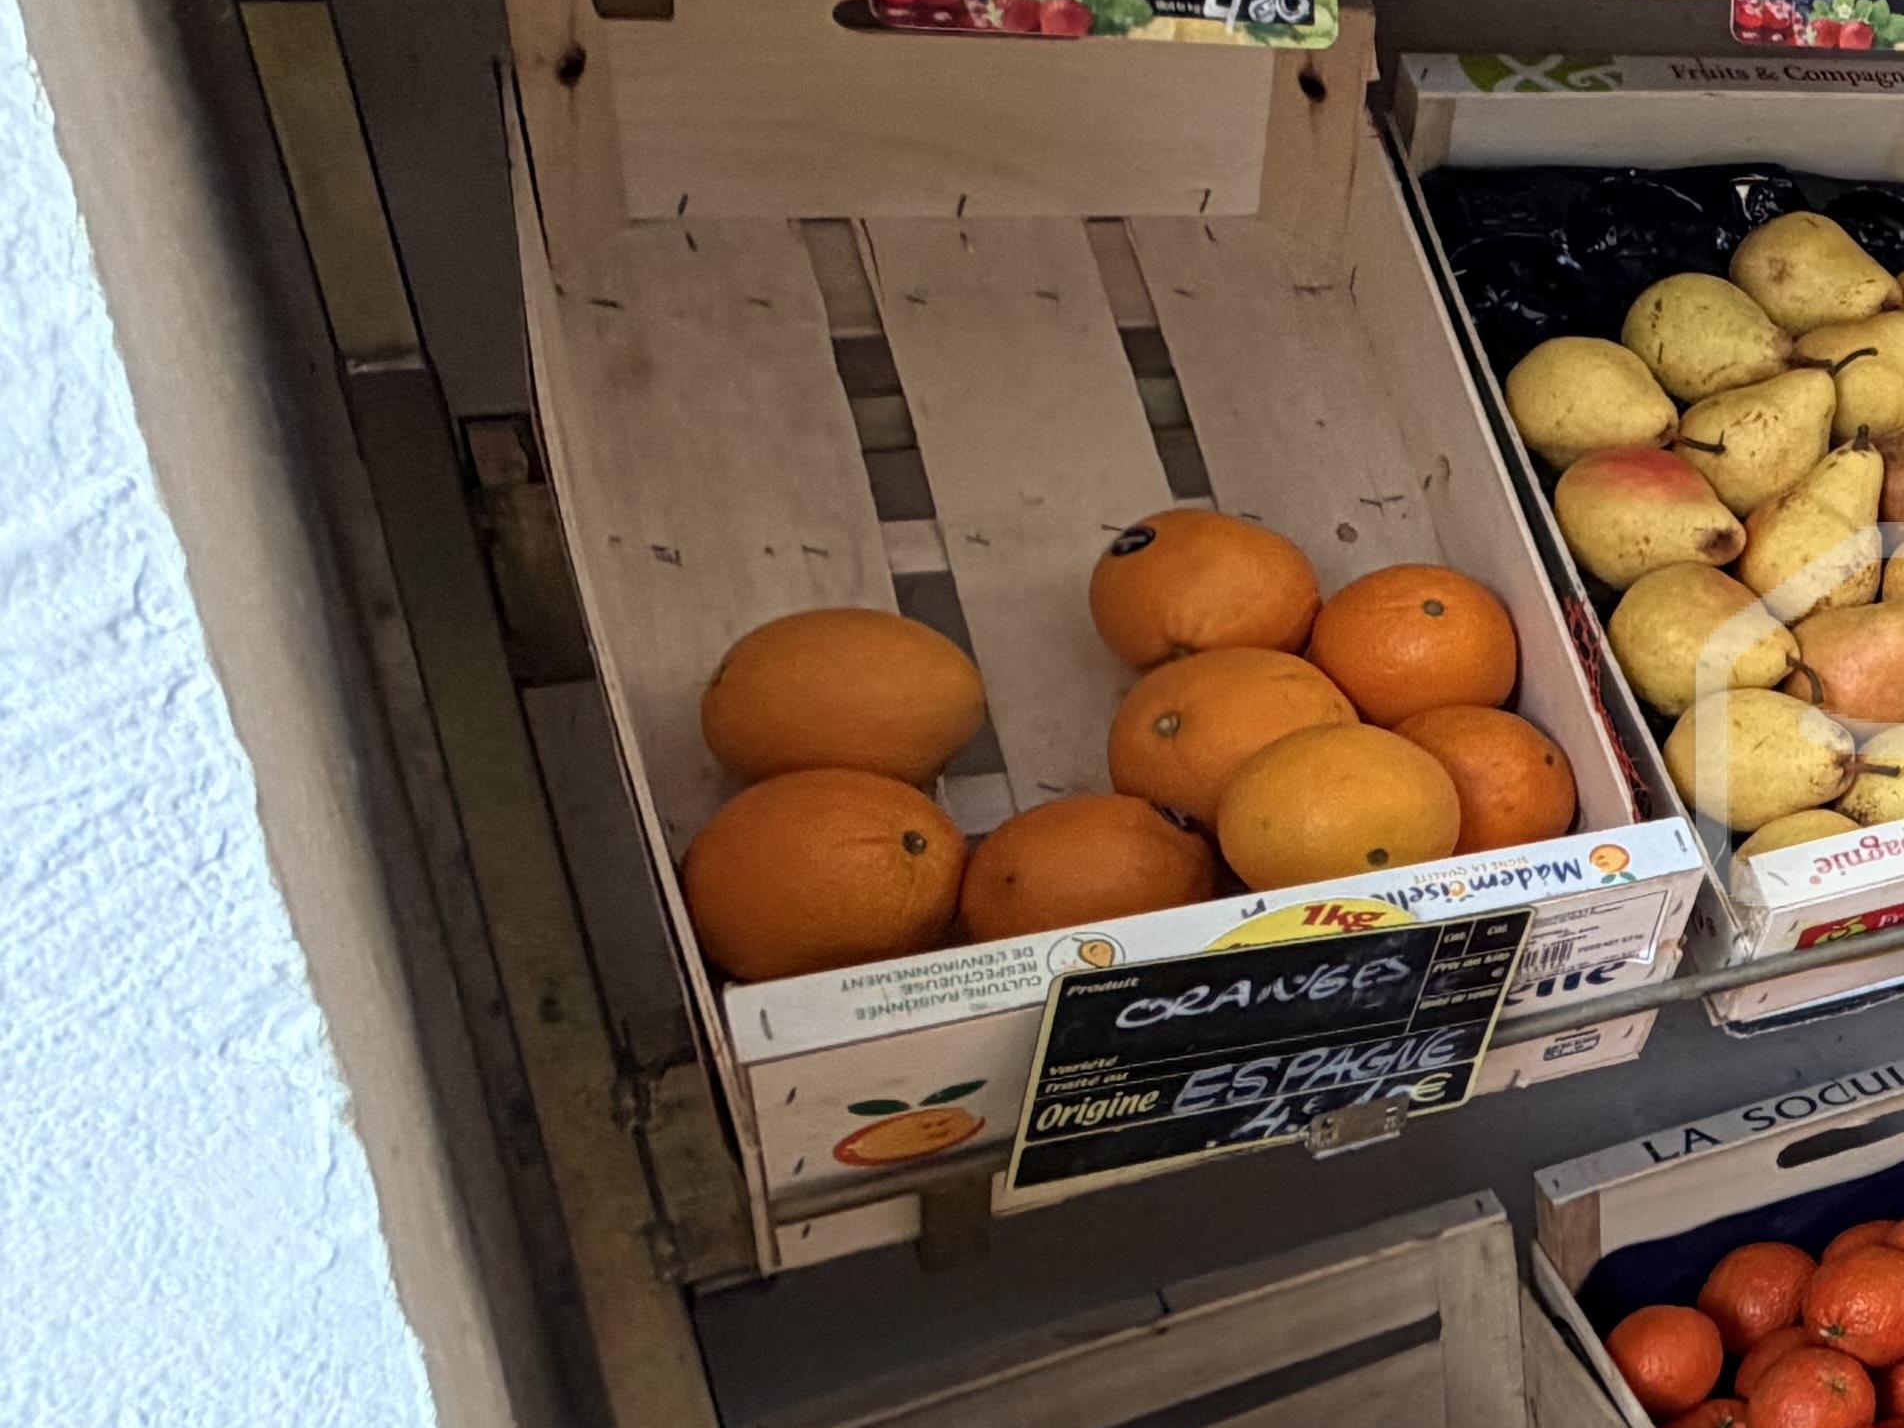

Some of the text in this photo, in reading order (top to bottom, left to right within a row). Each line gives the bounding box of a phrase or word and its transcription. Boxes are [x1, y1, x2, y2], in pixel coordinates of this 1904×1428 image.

[1670, 63, 1749, 84] Fruits
[1756, 65, 1779, 81] &
[1300, 902, 1386, 932] 1kg
[1012, 946, 1034, 960] DE
[1116, 956, 1411, 1029] ORANGES
[1036, 1029, 1465, 1132] Origine ESPAGNE
[1410, 1074, 1453, 1102] €
[1642, 1127, 1722, 1165] LA
